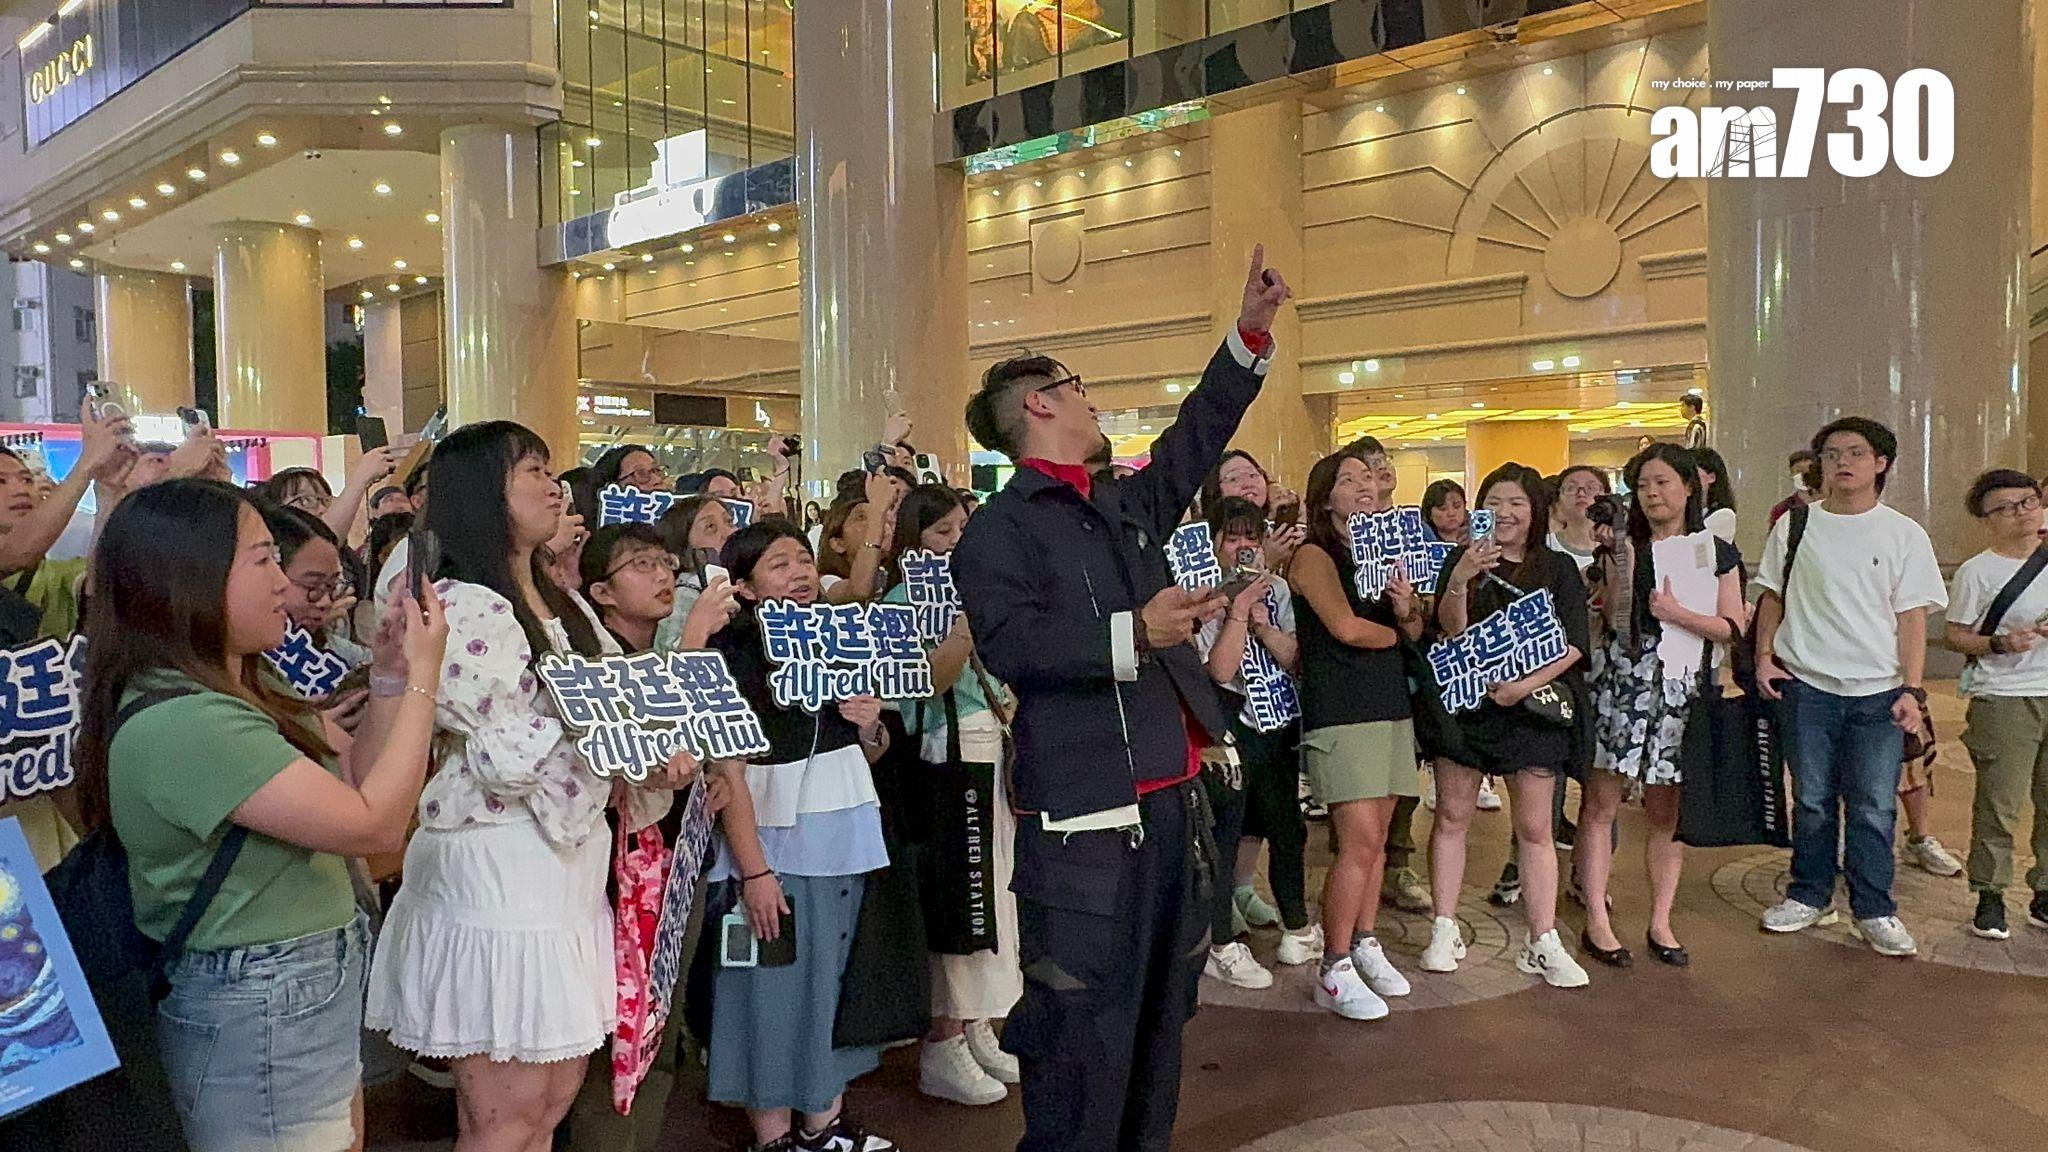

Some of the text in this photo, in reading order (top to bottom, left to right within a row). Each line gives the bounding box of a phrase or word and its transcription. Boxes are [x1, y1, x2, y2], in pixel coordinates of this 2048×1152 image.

[31, 34, 93, 104] GUCCI
[1164, 525, 1216, 574] 鏗
[1350, 510, 1425, 562] 許廷鏗
[1403, 553, 1428, 581] Hui
[903, 553, 956, 605] 許
[761, 602, 925, 662] 許廷鏗
[1429, 592, 1557, 682] 許廷鏗
[546, 655, 746, 723] 許廷鏗
[772, 660, 933, 709] Alfred Hui
[1442, 629, 1566, 713] Alfred Hui
[582, 713, 767, 777] Alfred Hui
[965, 806, 986, 937] ALFRED STATION
